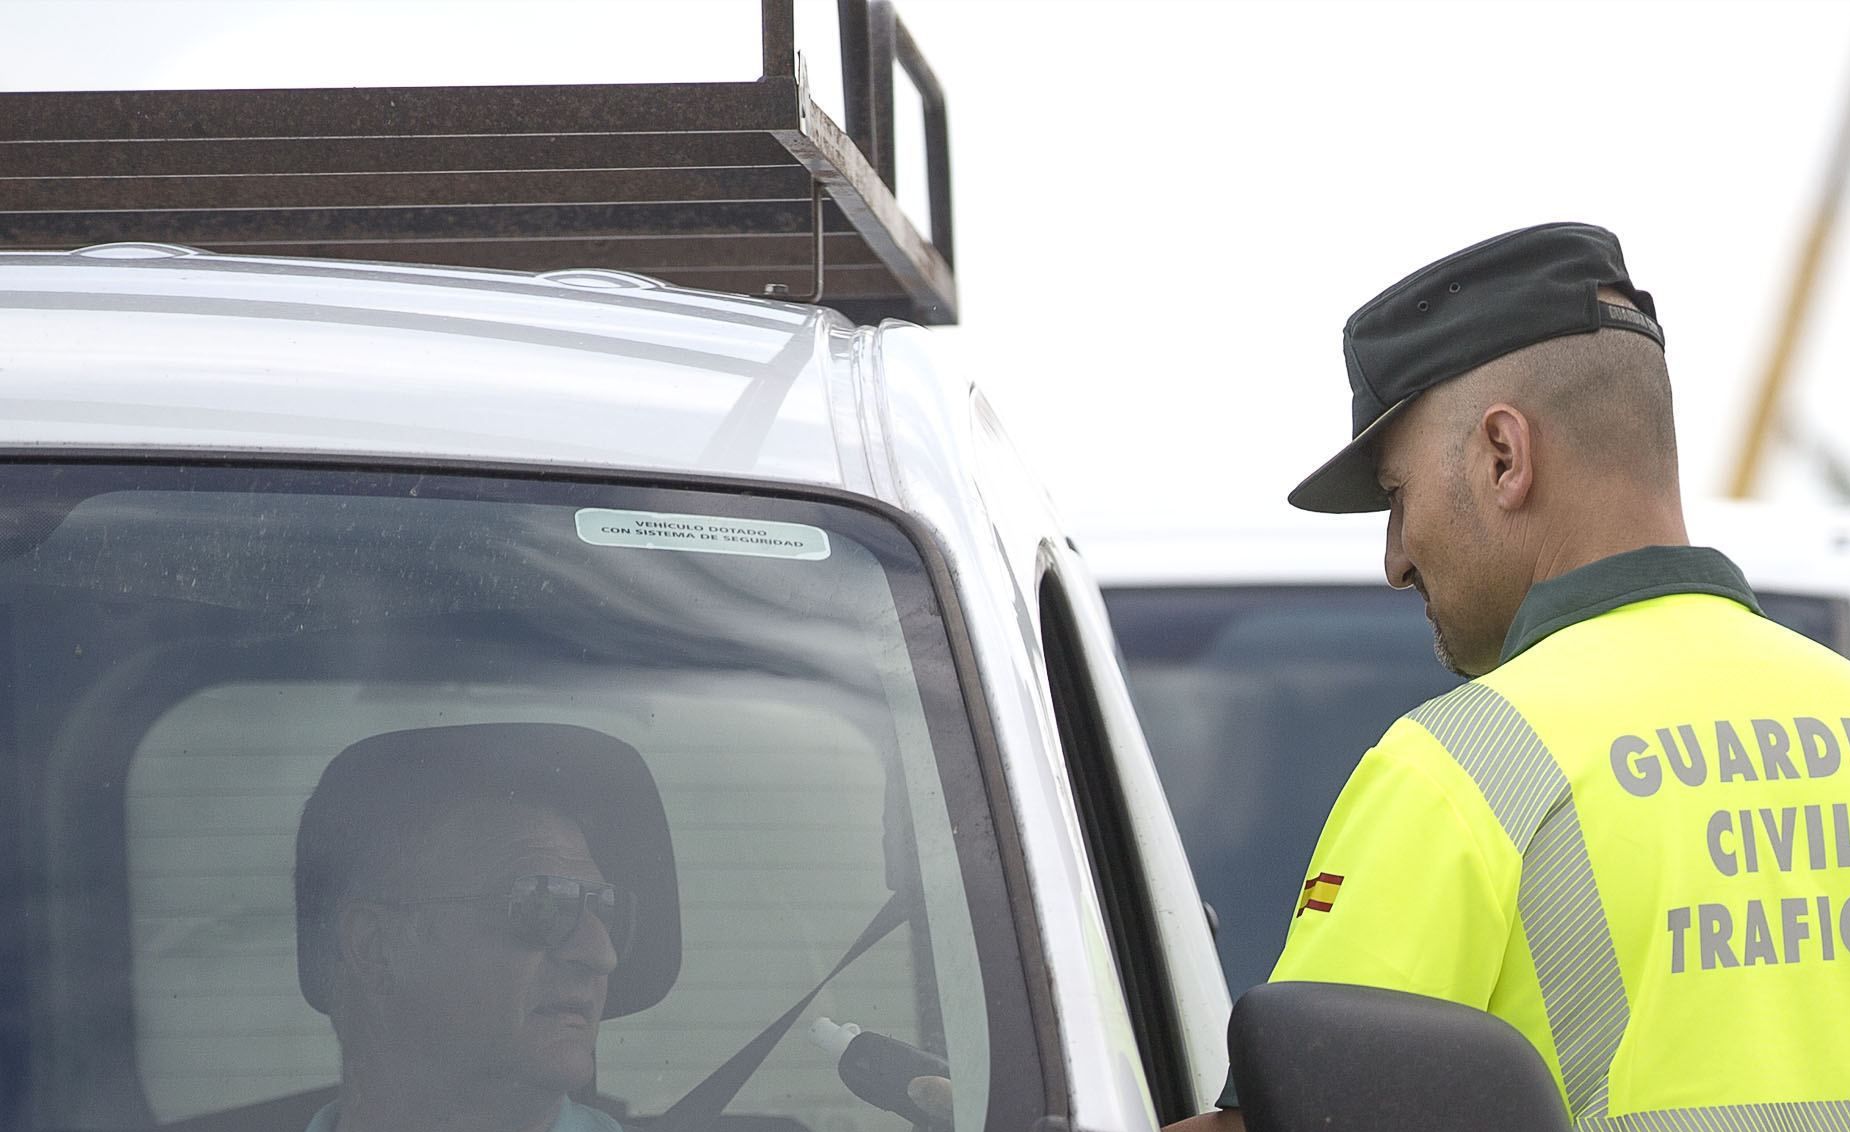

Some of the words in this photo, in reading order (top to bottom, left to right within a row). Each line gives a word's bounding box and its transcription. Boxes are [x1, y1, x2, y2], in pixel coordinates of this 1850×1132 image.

[635, 520, 704, 531] VEHÍCULO
[708, 526, 767, 536] DOTADO
[635, 529, 695, 539] SISTEMA
[723, 535, 804, 547] SEGURIDAD
